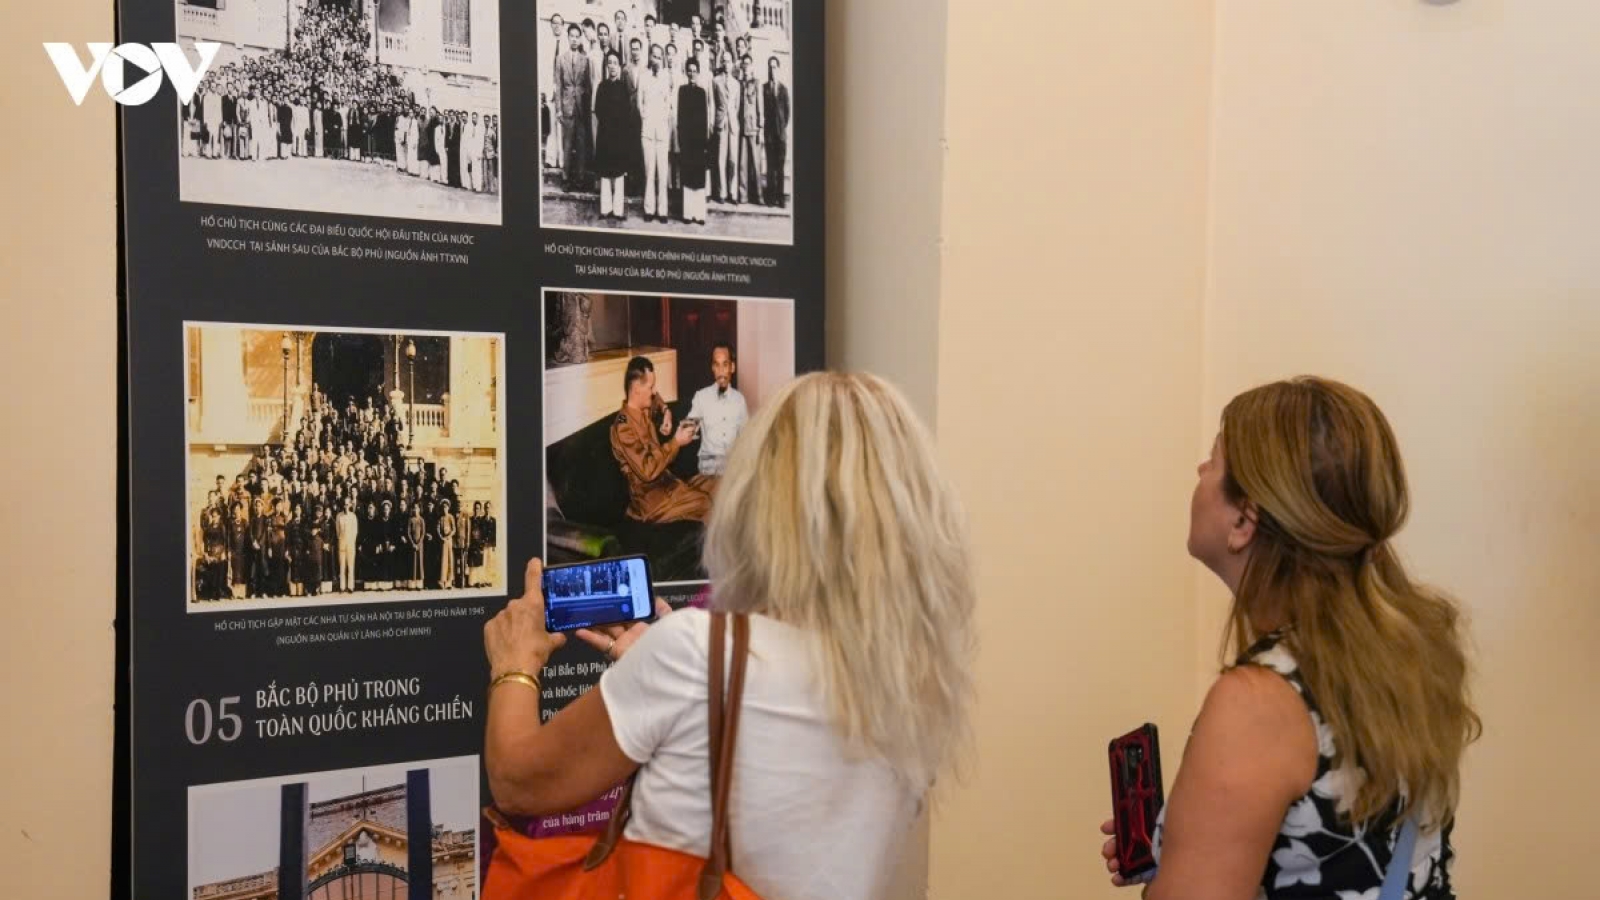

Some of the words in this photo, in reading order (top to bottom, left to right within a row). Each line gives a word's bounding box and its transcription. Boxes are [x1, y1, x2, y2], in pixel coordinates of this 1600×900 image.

[543, 665, 557, 679] Tại
[558, 662, 576, 676] Bắc
[576, 662, 589, 676] Bộ
[255, 680, 291, 709] BẮC
[295, 681, 319, 708] BỘ
[323, 678, 358, 703] PHỦ
[363, 677, 421, 699] TRONG
[542, 687, 553, 699] và
[184, 695, 243, 745] 05
[255, 714, 304, 739] TOÀN
[308, 705, 357, 736] QUỐC
[361, 704, 420, 728] KHÁNG
[423, 695, 473, 722] CHIẾN
[542, 817, 560, 828] của
[562, 814, 585, 827] hàng
[587, 810, 610, 822] trăm
